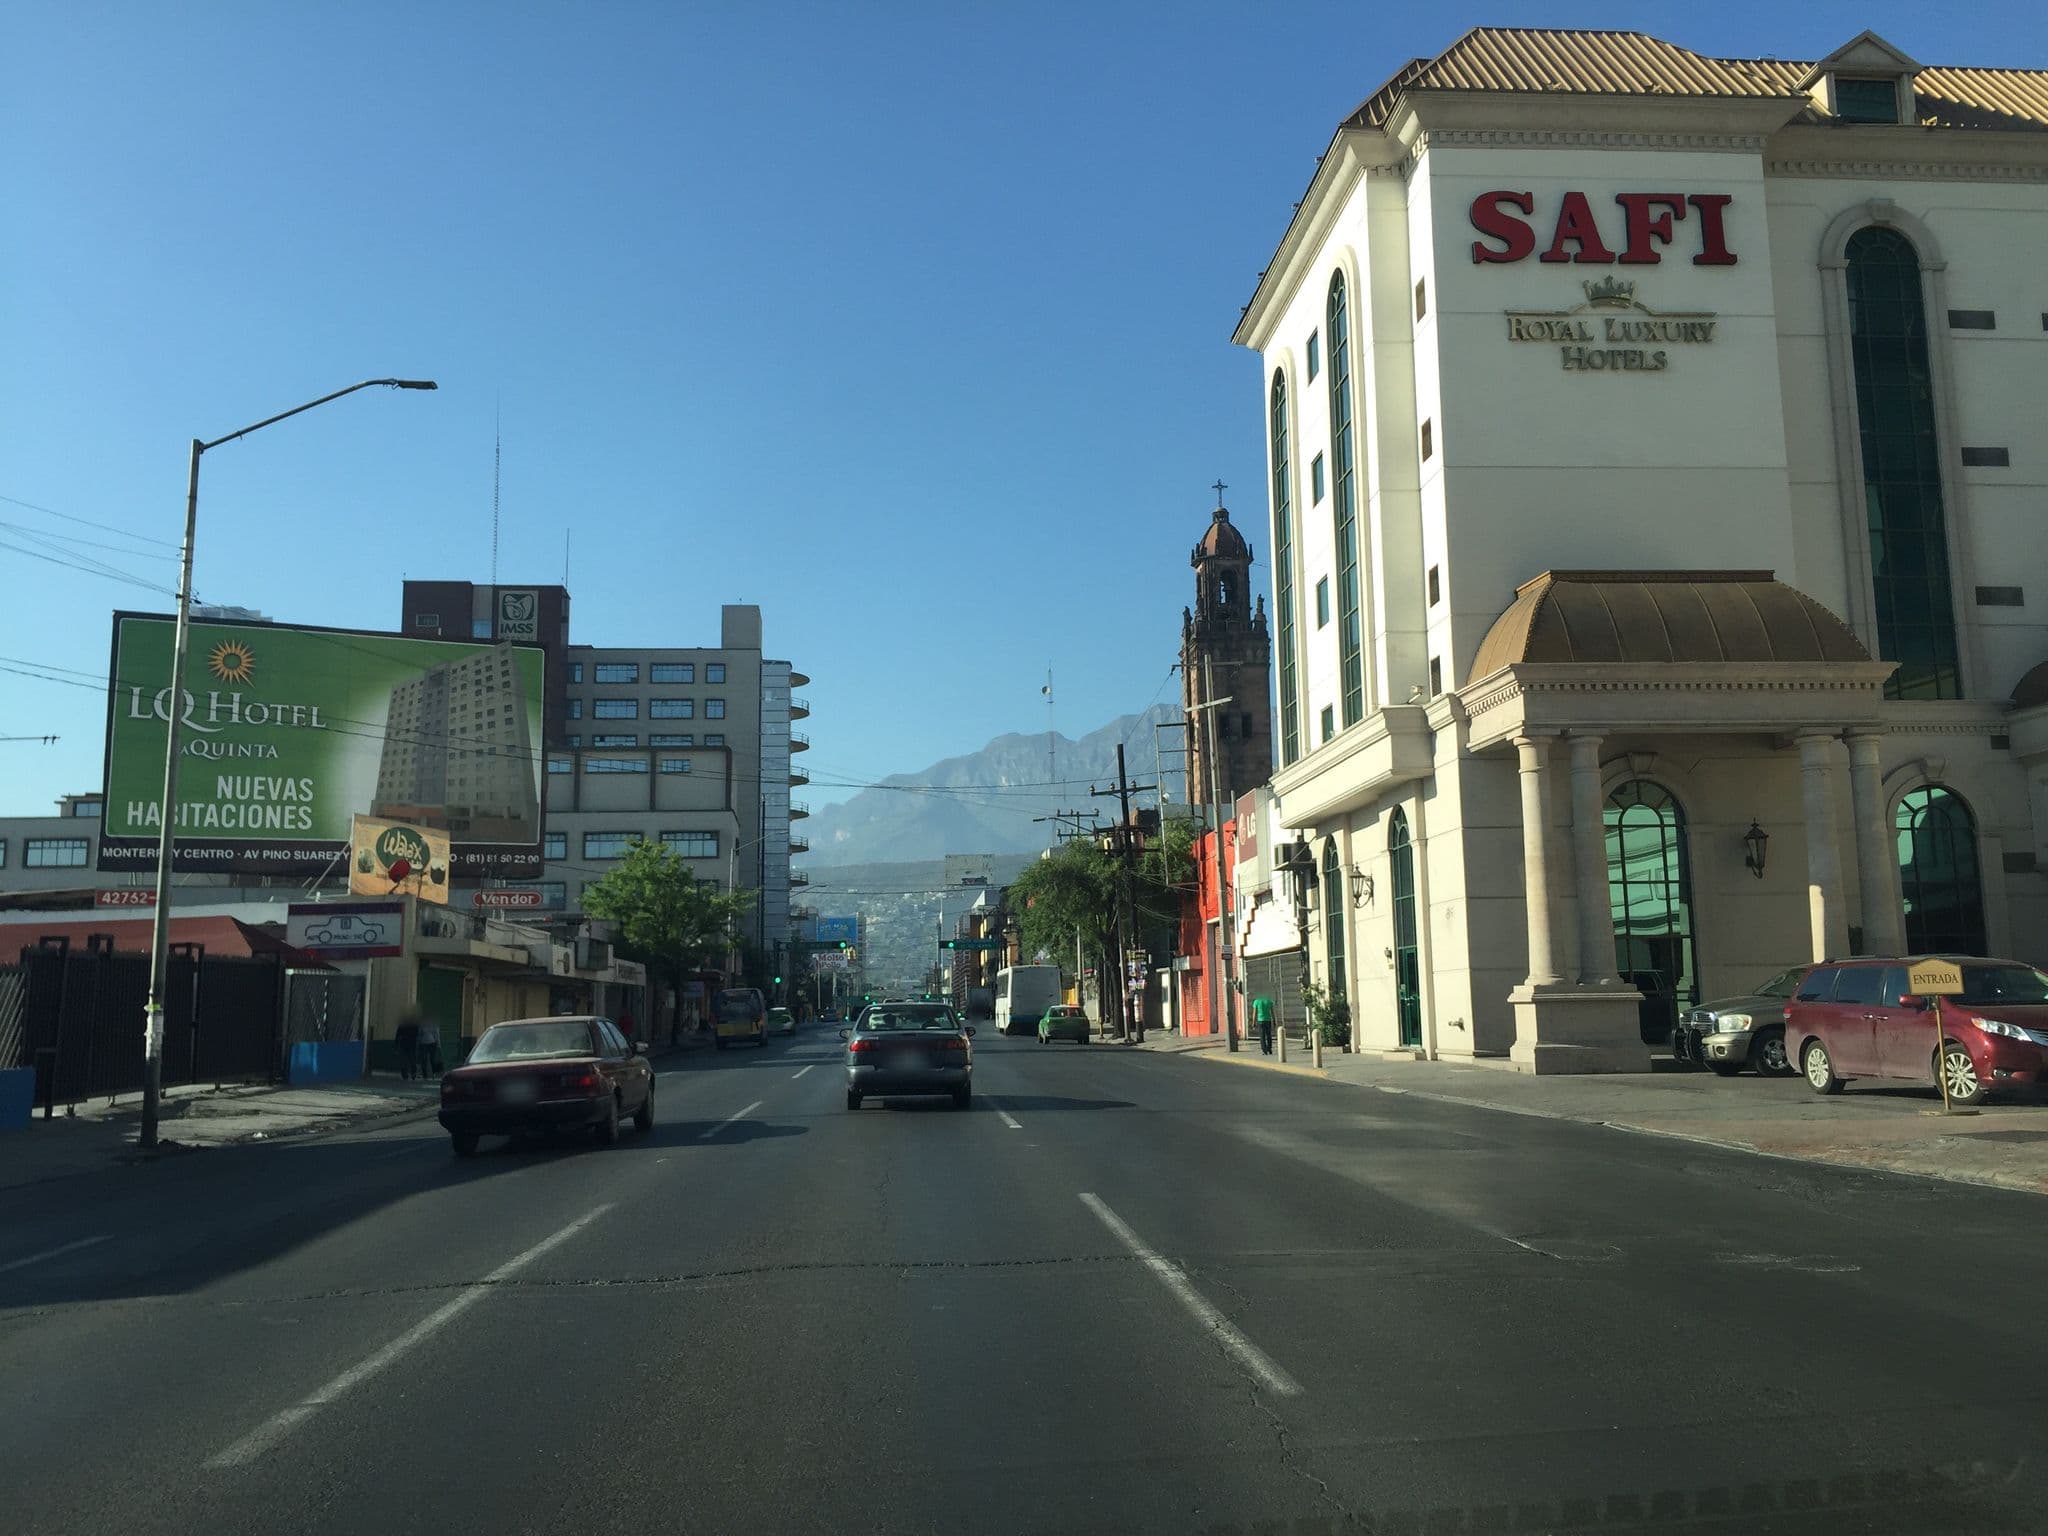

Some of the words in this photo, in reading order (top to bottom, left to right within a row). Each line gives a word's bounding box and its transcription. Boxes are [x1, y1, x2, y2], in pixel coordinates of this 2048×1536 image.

[1470, 190, 1738, 265] SAFI
[1507, 317, 1594, 342] ROYAL
[1604, 317, 1717, 343] LUXURY
[1560, 346, 1668, 371] HOTELS
[501, 623, 533, 634] IMSS
[128, 686, 224, 733] LQ
[206, 691, 326, 728] HOTEL
[180, 738, 279, 760] AQUINTA
[216, 775, 314, 802] NUEVAS
[127, 801, 313, 830] HAITACIONES
[1246, 811, 1256, 840] LG
[102, 847, 182, 859] MONTERRY
[184, 849, 234, 859] CENTRO
[243, 850, 261, 859] AV
[263, 850, 291, 860] PINO
[293, 850, 340, 861] SUAREZ
[466, 854, 485, 865] (81)
[482, 893, 534, 905] Vendor
[1912, 973, 1959, 985] ENTRADA
